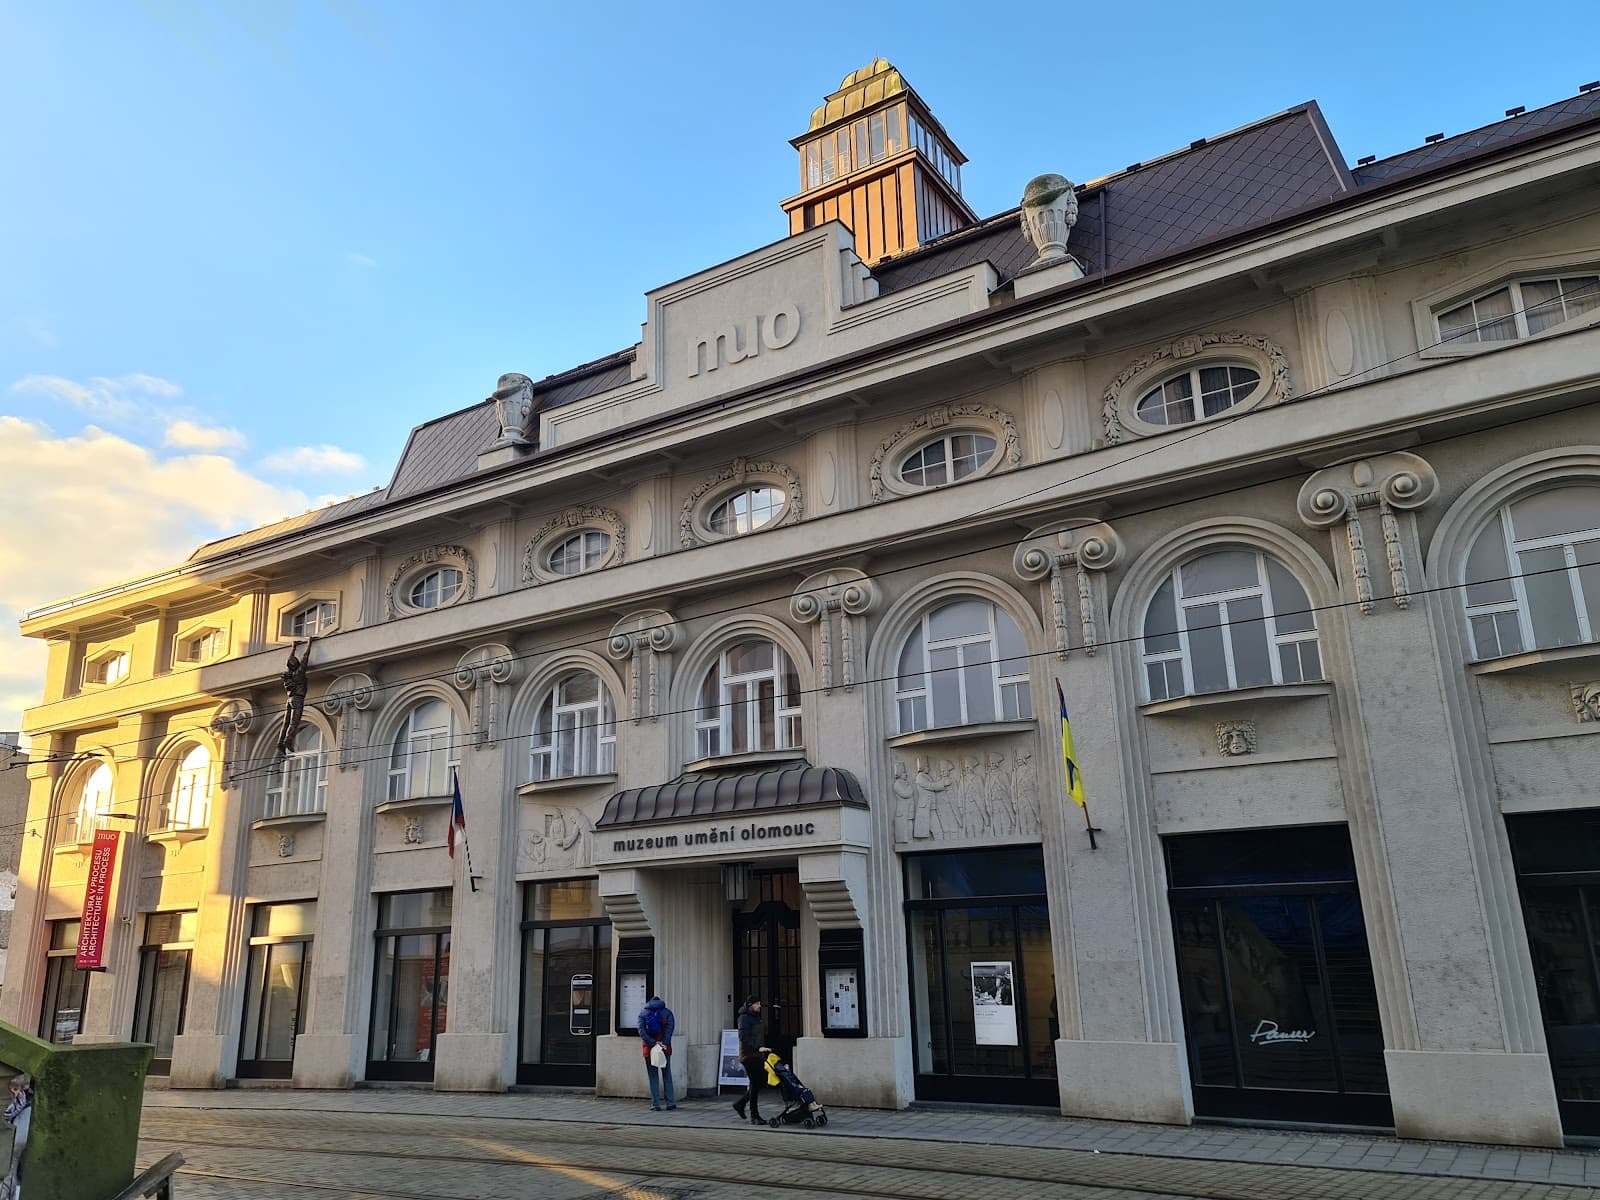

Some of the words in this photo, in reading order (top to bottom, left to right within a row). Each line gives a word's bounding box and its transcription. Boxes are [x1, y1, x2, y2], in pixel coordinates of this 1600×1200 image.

[687, 303, 801, 378] muo
[613, 835, 678, 852] muzeum
[684, 827, 735, 846] umění
[740, 823, 815, 841] olomouc
[97, 885, 105, 894] IN
[98, 847, 111, 884] PROCESS
[80, 895, 96, 957] ARCHITEKTURA
[90, 849, 103, 887] PROCESU
[88, 895, 104, 957] ARCHITECTURE
